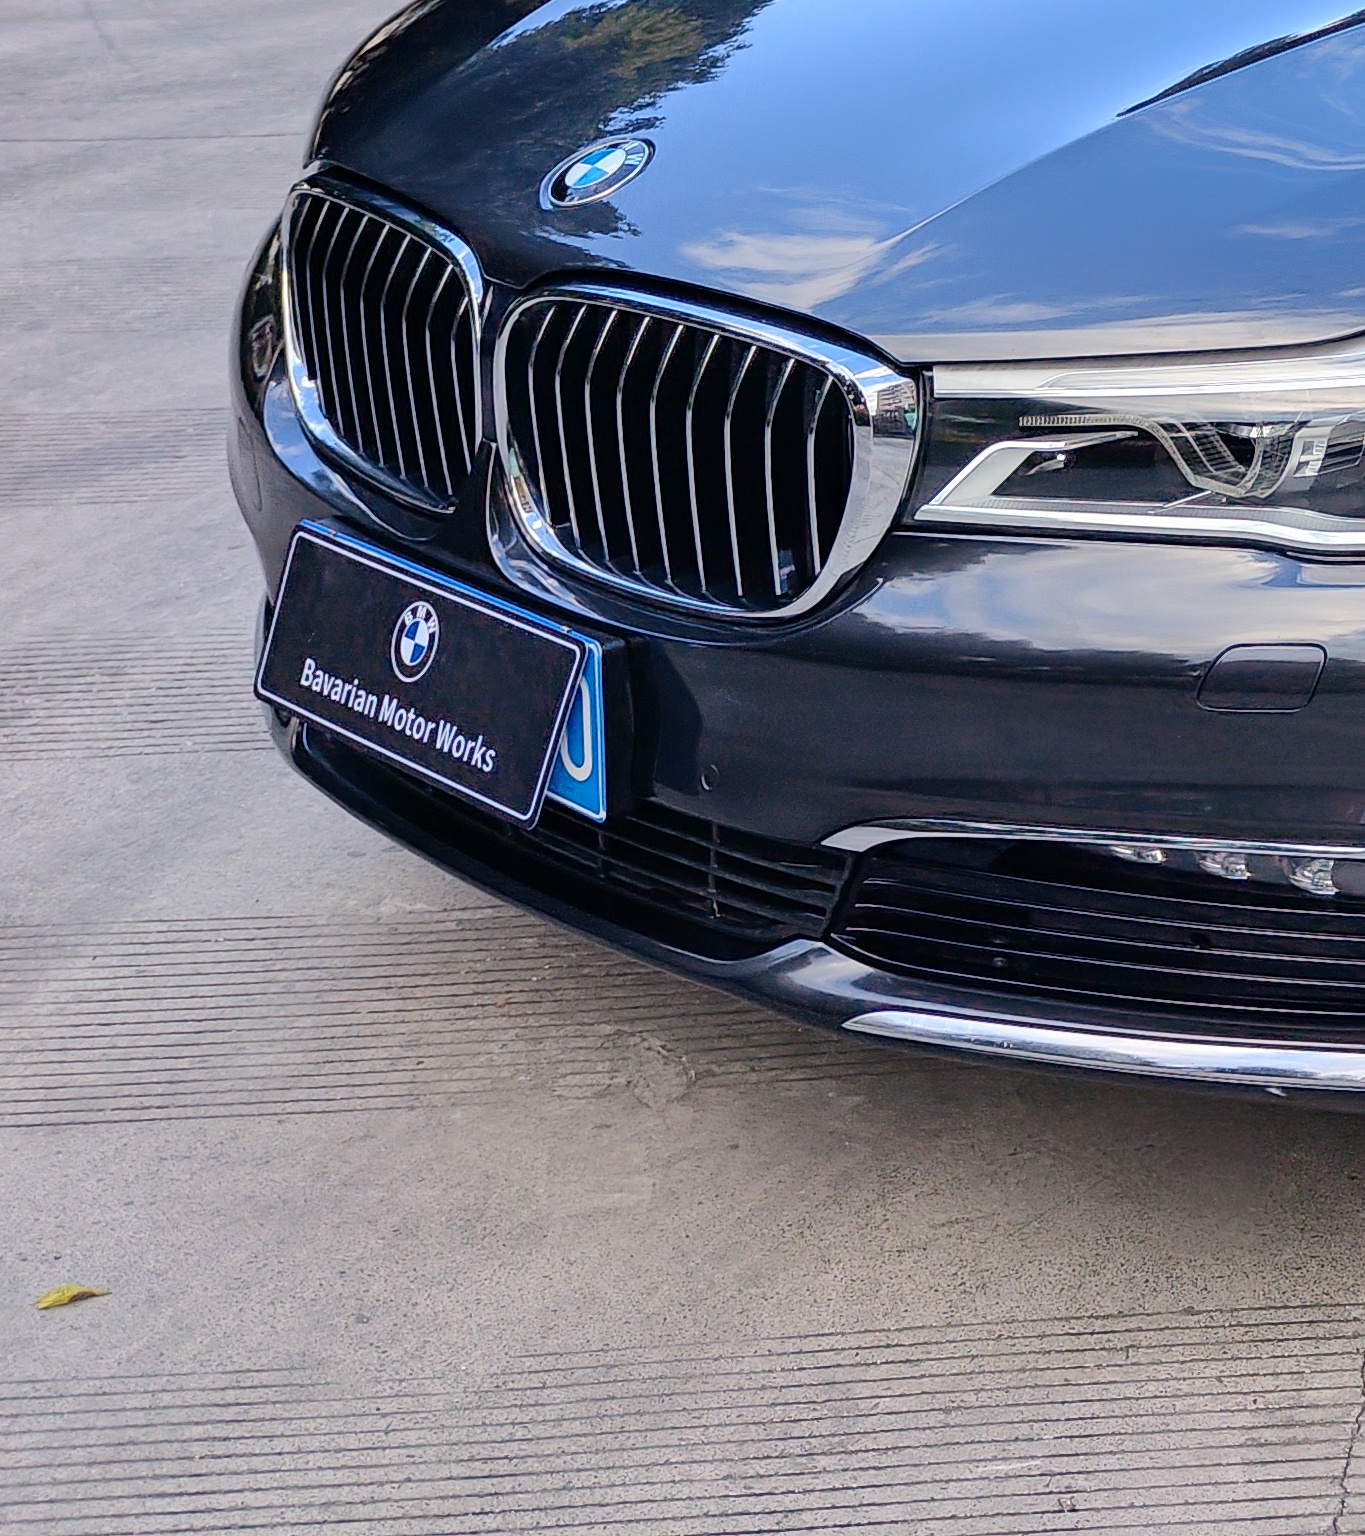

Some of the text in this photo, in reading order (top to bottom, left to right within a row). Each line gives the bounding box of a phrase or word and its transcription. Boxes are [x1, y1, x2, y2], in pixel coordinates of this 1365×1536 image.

[403, 605, 437, 635] BMW
[300, 657, 378, 718] Bavarian
[378, 693, 436, 745] Motor
[435, 719, 497, 774] Works
